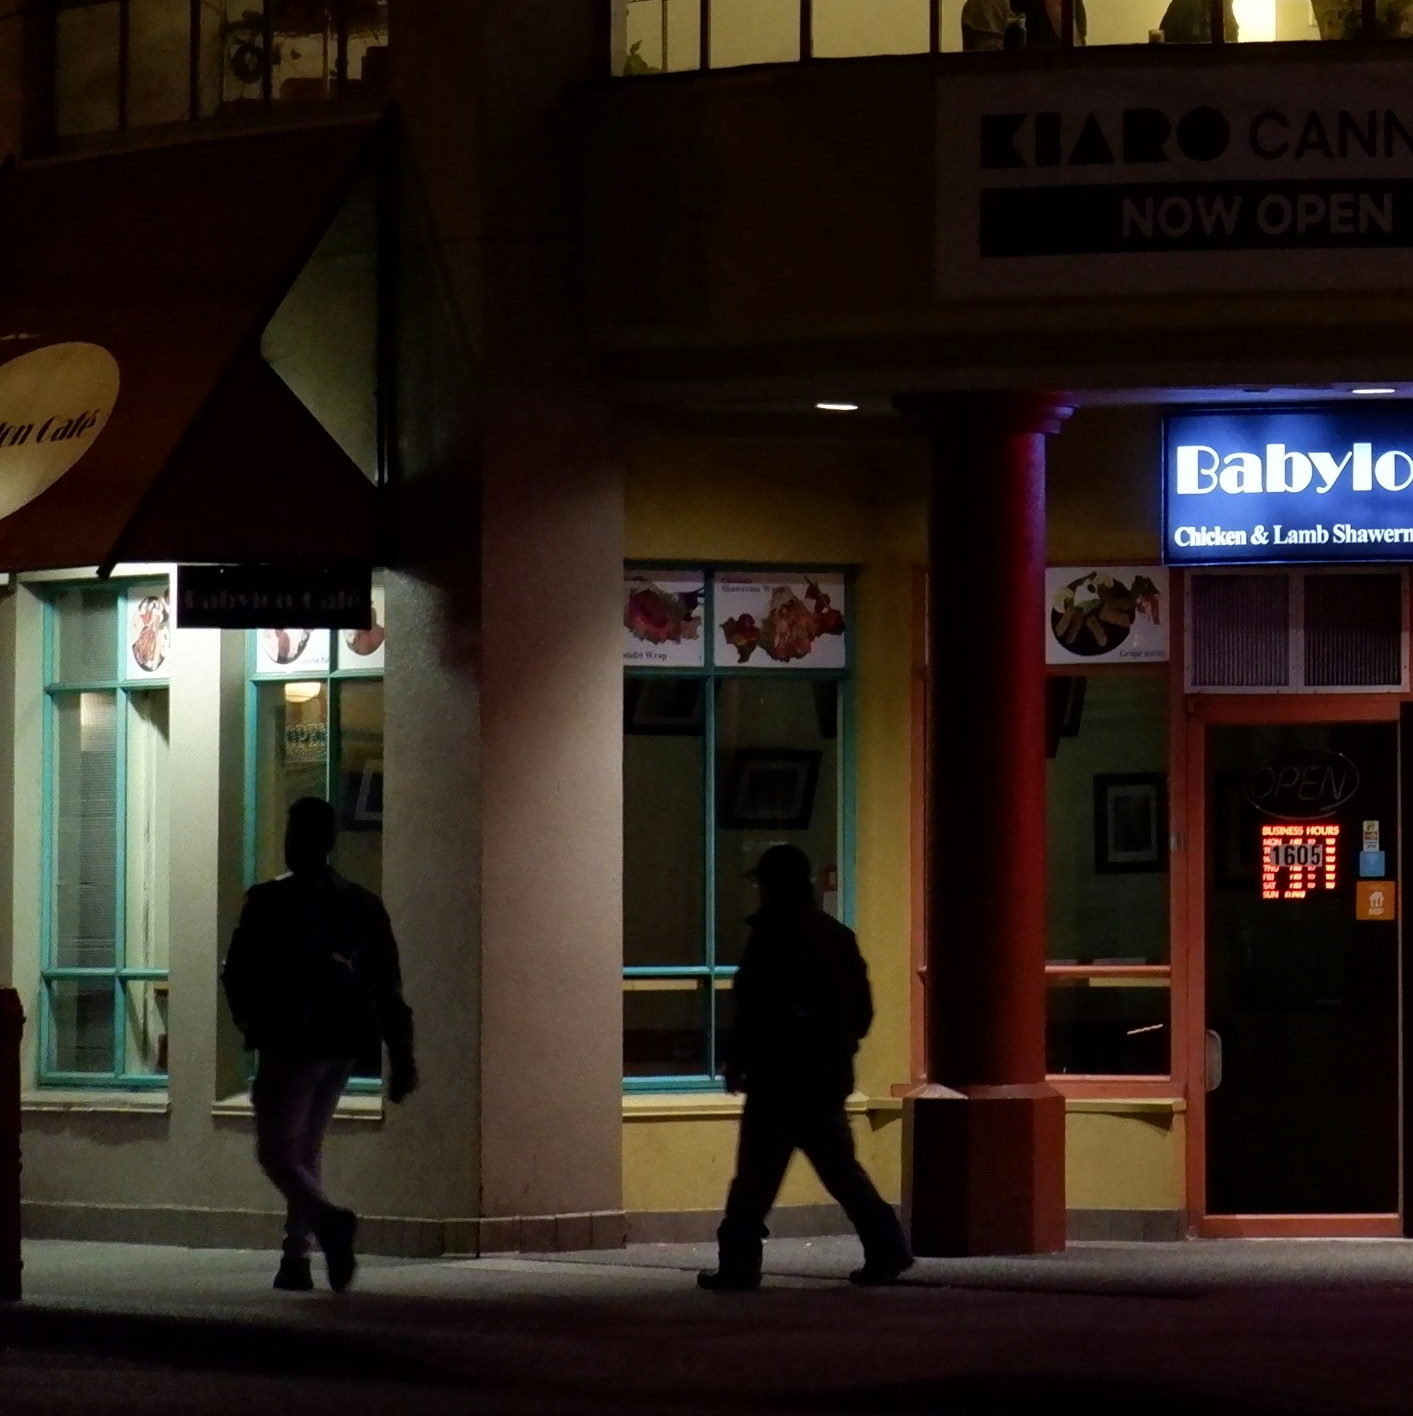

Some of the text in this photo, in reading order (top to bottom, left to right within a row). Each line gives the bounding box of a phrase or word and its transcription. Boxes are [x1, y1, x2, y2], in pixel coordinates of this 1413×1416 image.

[980, 106, 1230, 169] KIARO
[1121, 191, 1394, 240] NOW OPEN
[1174, 523, 1247, 547] Chicken
[1250, 527, 1270, 544] &
[1272, 523, 1329, 545] Lamb
[1252, 765, 1347, 800] OPEN
[1262, 826, 1340, 836] BUSINESS HOURS
[1273, 845, 1320, 866] 1605
